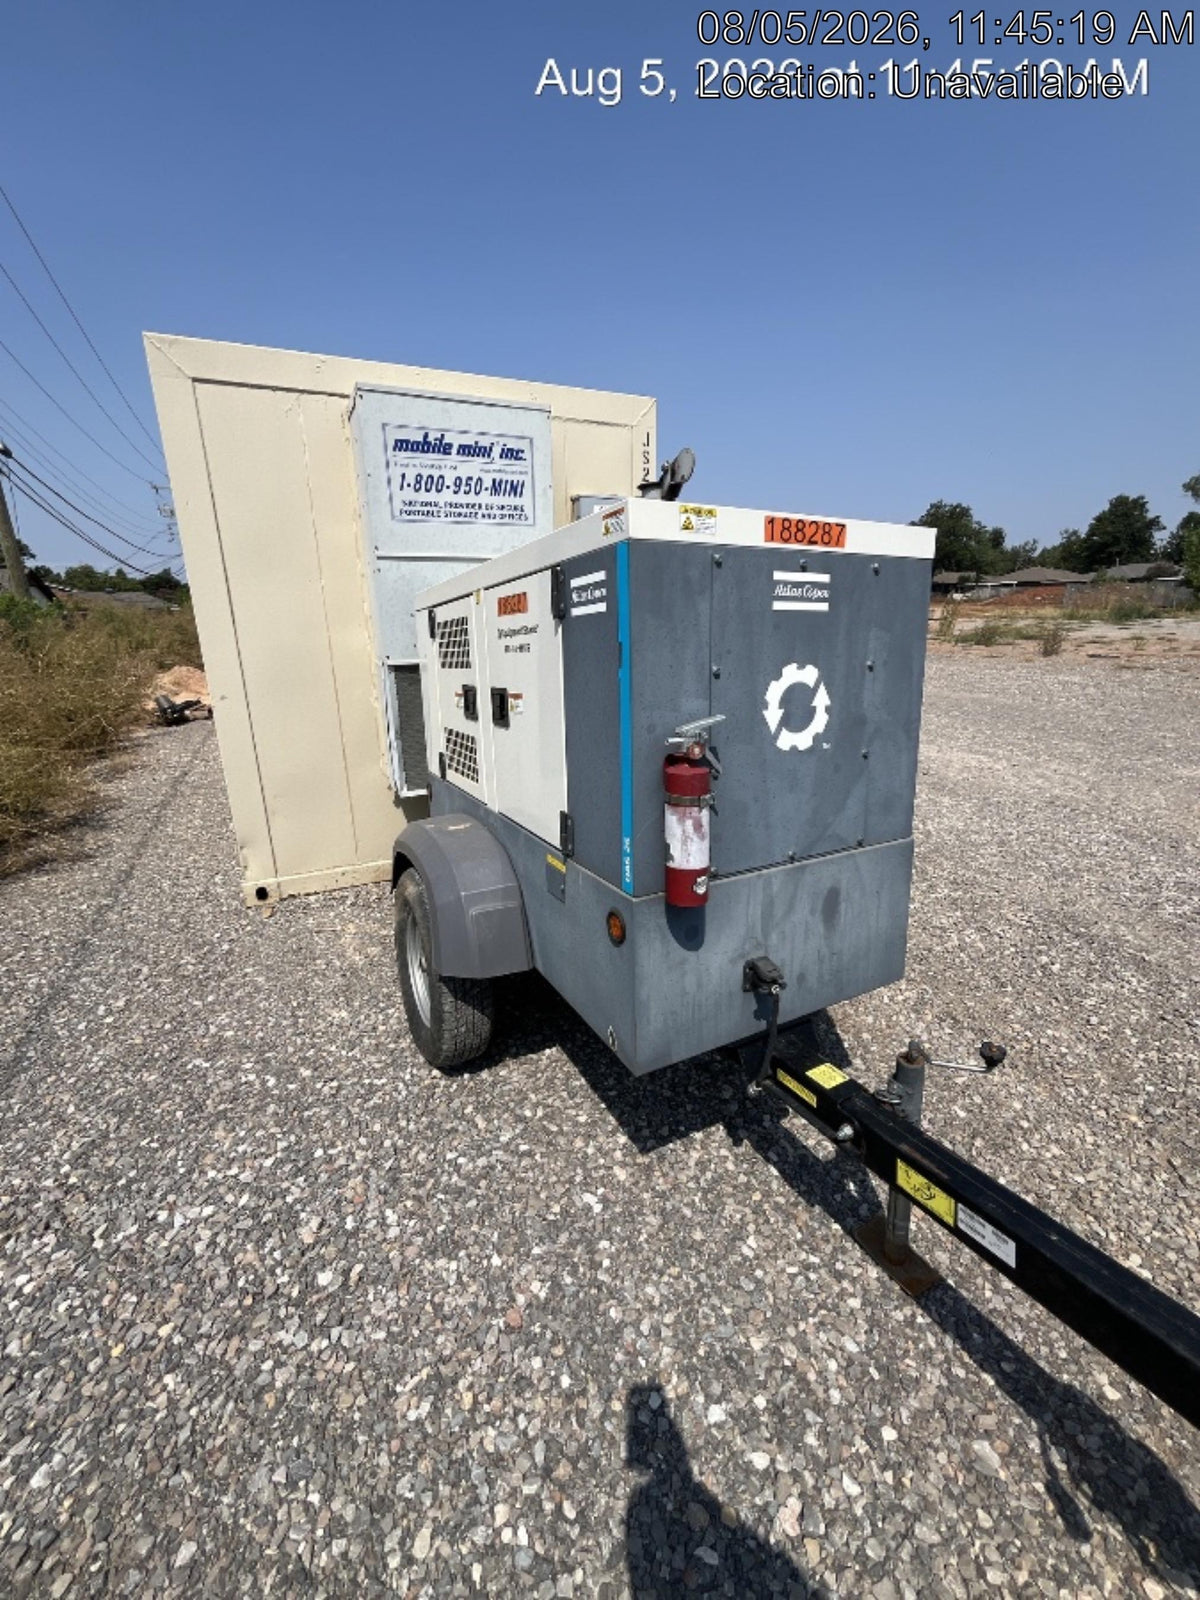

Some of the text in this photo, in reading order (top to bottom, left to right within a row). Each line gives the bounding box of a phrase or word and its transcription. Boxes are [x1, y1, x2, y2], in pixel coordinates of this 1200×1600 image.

[392, 432, 454, 456] mobile
[499, 444, 527, 462] inc.
[399, 472, 526, 498] 1-800-950-MINI
[767, 516, 846, 546] 188287
